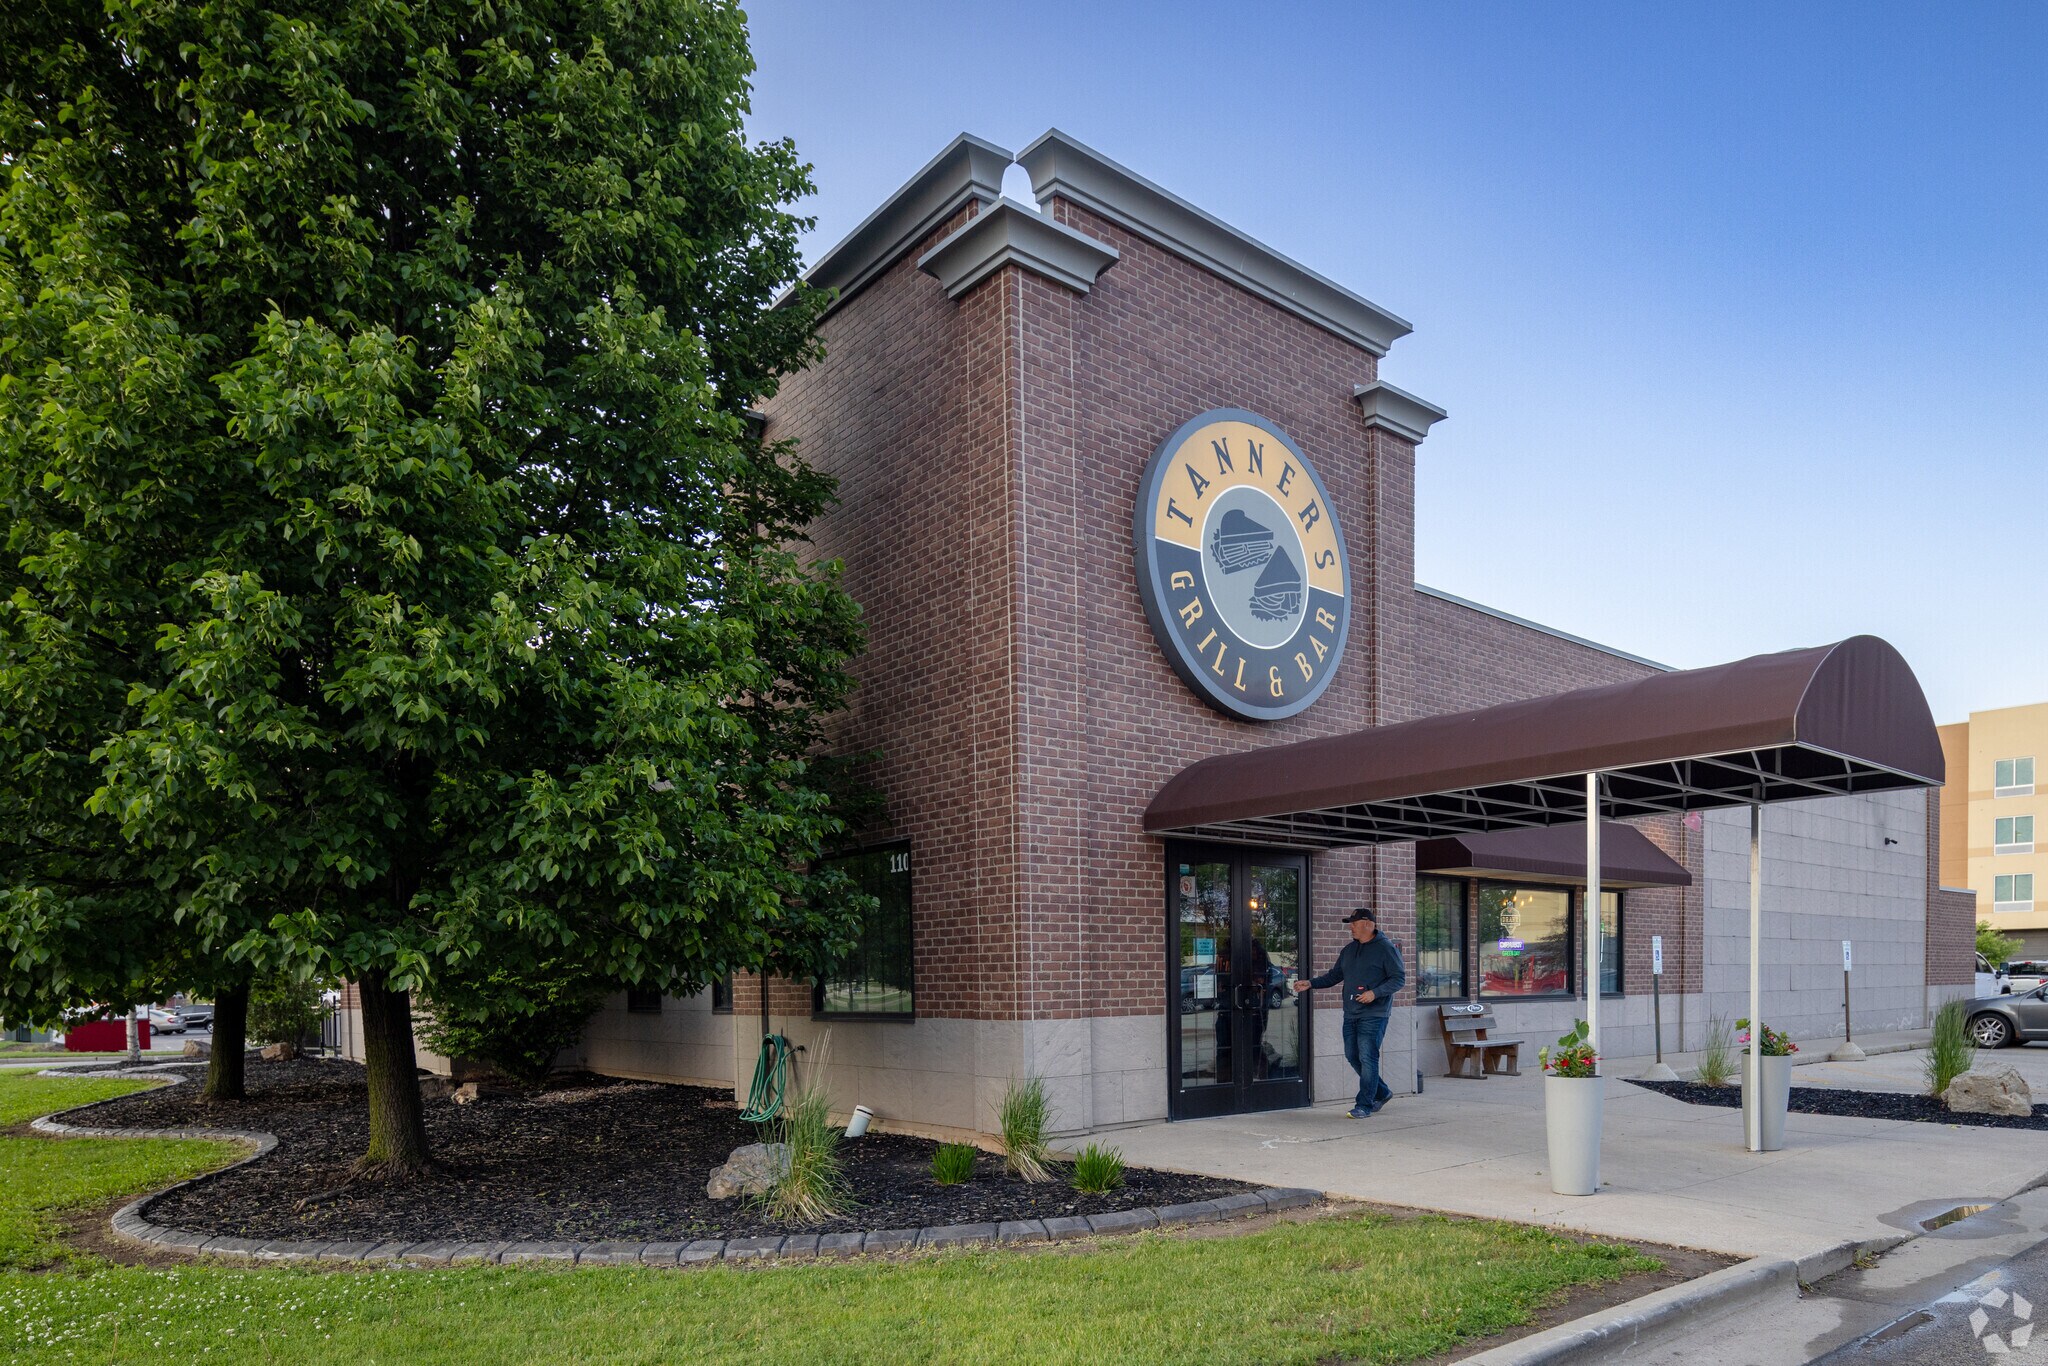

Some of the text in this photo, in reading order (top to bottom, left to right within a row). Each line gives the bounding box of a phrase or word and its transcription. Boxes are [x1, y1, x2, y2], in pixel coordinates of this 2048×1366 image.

[1166, 437, 1335, 570] TANNERS
[1170, 570, 1336, 697] GRILL & BAR
[890, 852, 909, 874] 110
